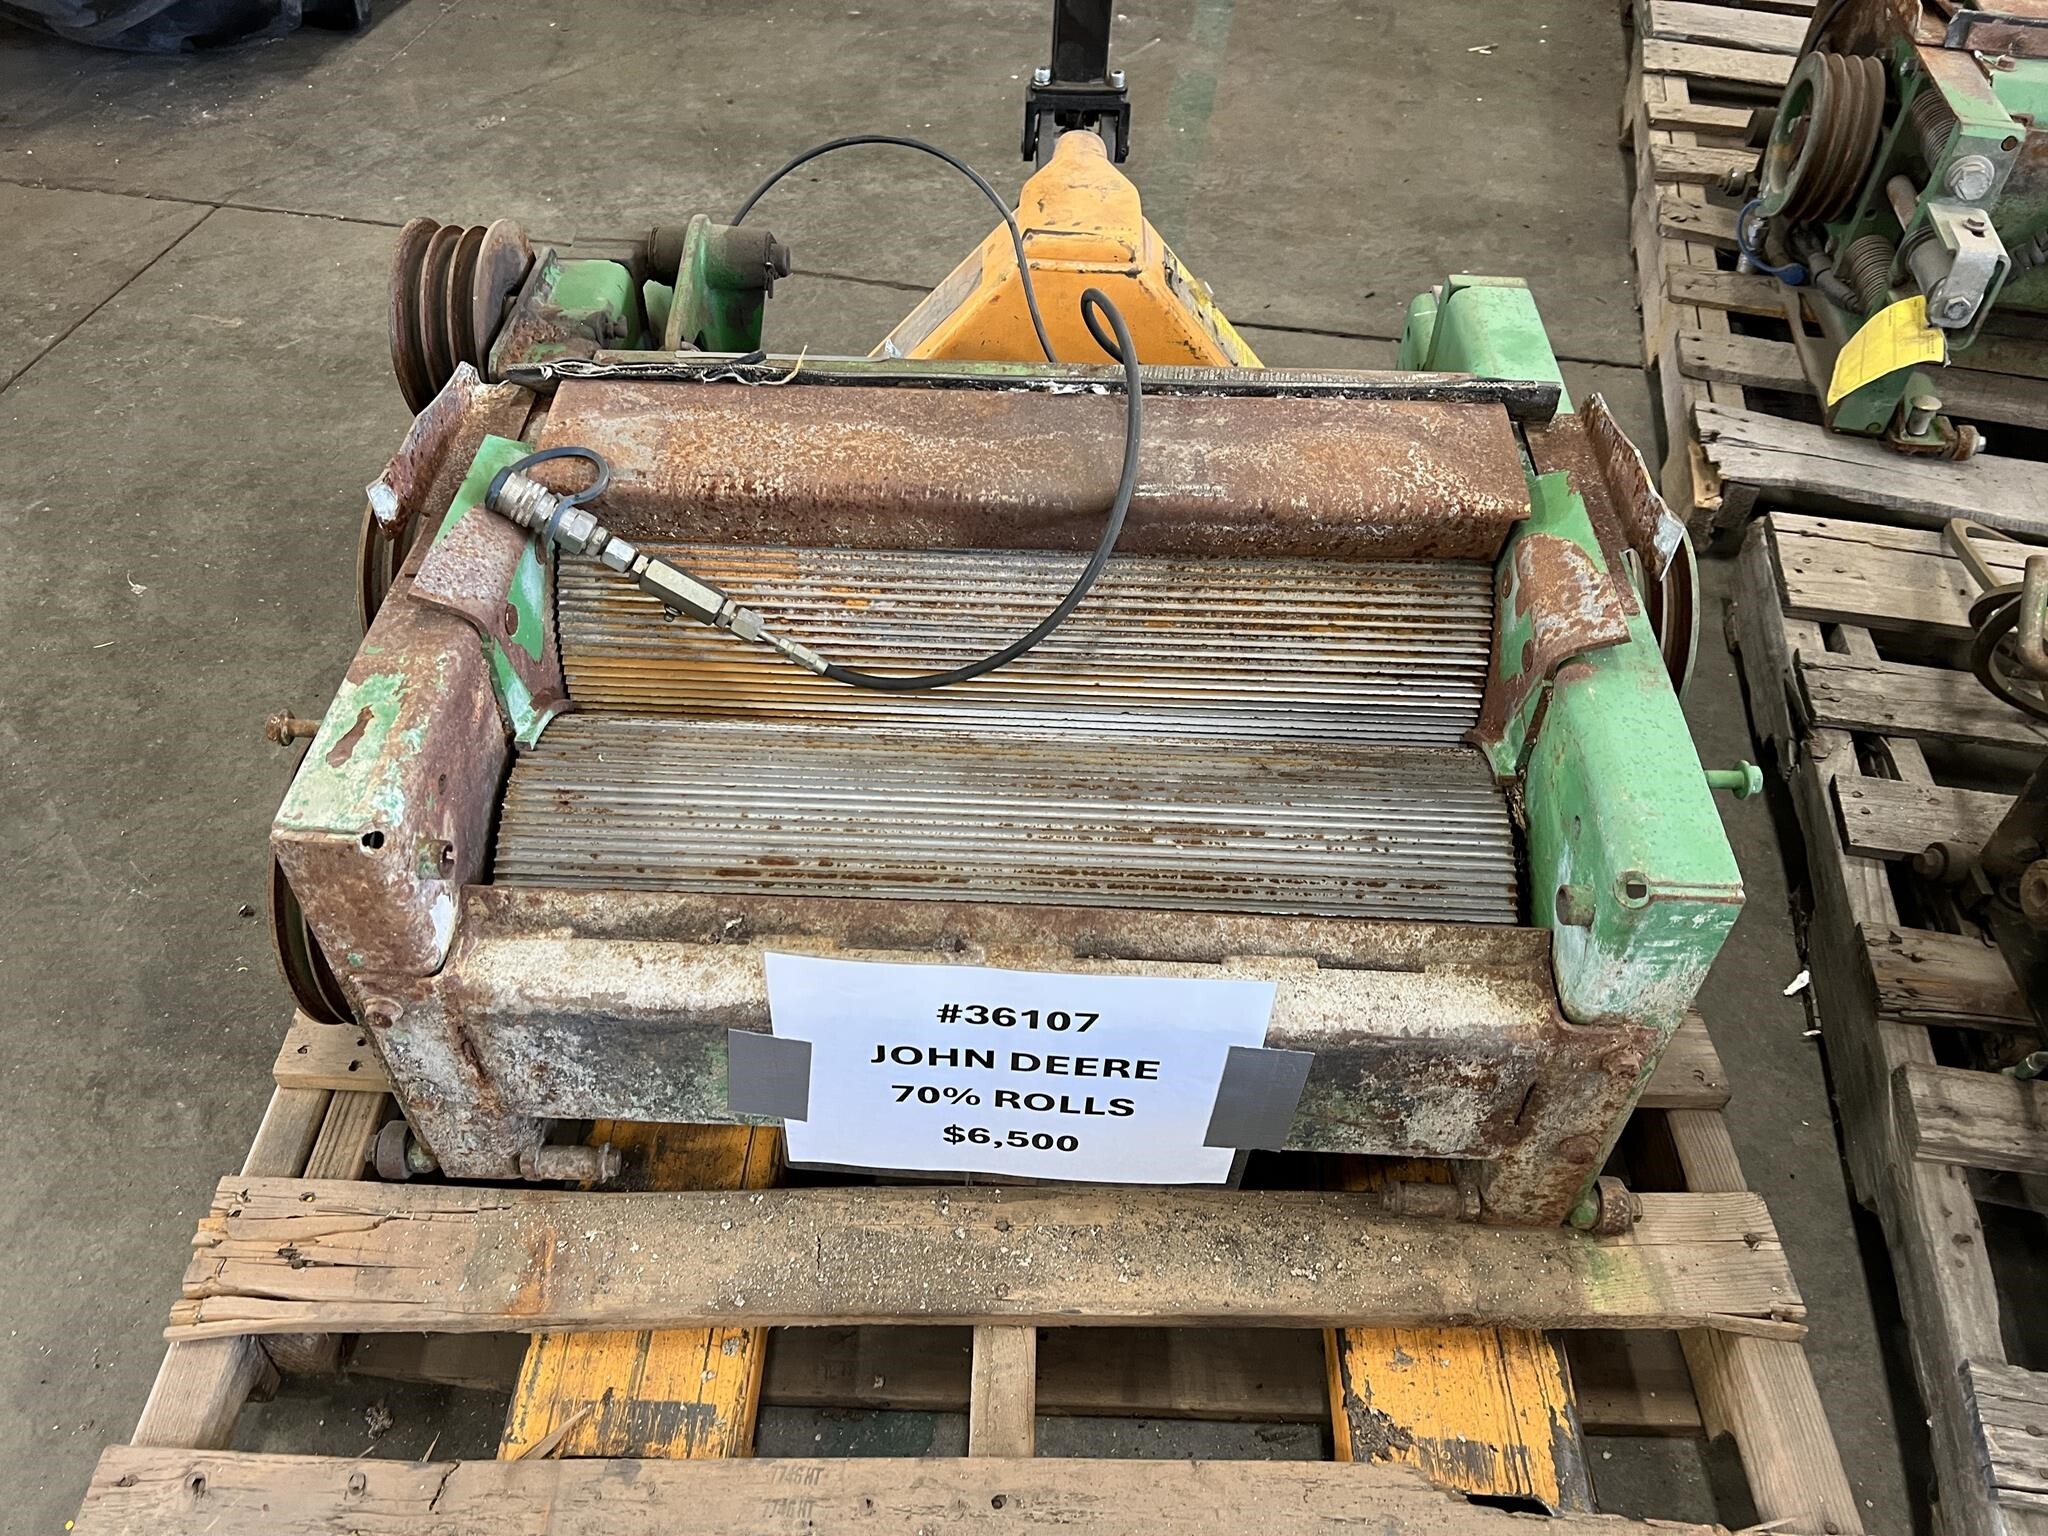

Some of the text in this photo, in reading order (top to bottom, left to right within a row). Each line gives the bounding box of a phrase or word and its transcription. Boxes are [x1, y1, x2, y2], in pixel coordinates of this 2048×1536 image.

[936, 1003, 1100, 1033] #36107
[870, 1044, 1161, 1080] JOHN DEERE
[891, 1084, 1135, 1117] 70% ROLLS
[942, 1123, 1079, 1152] $6,500
